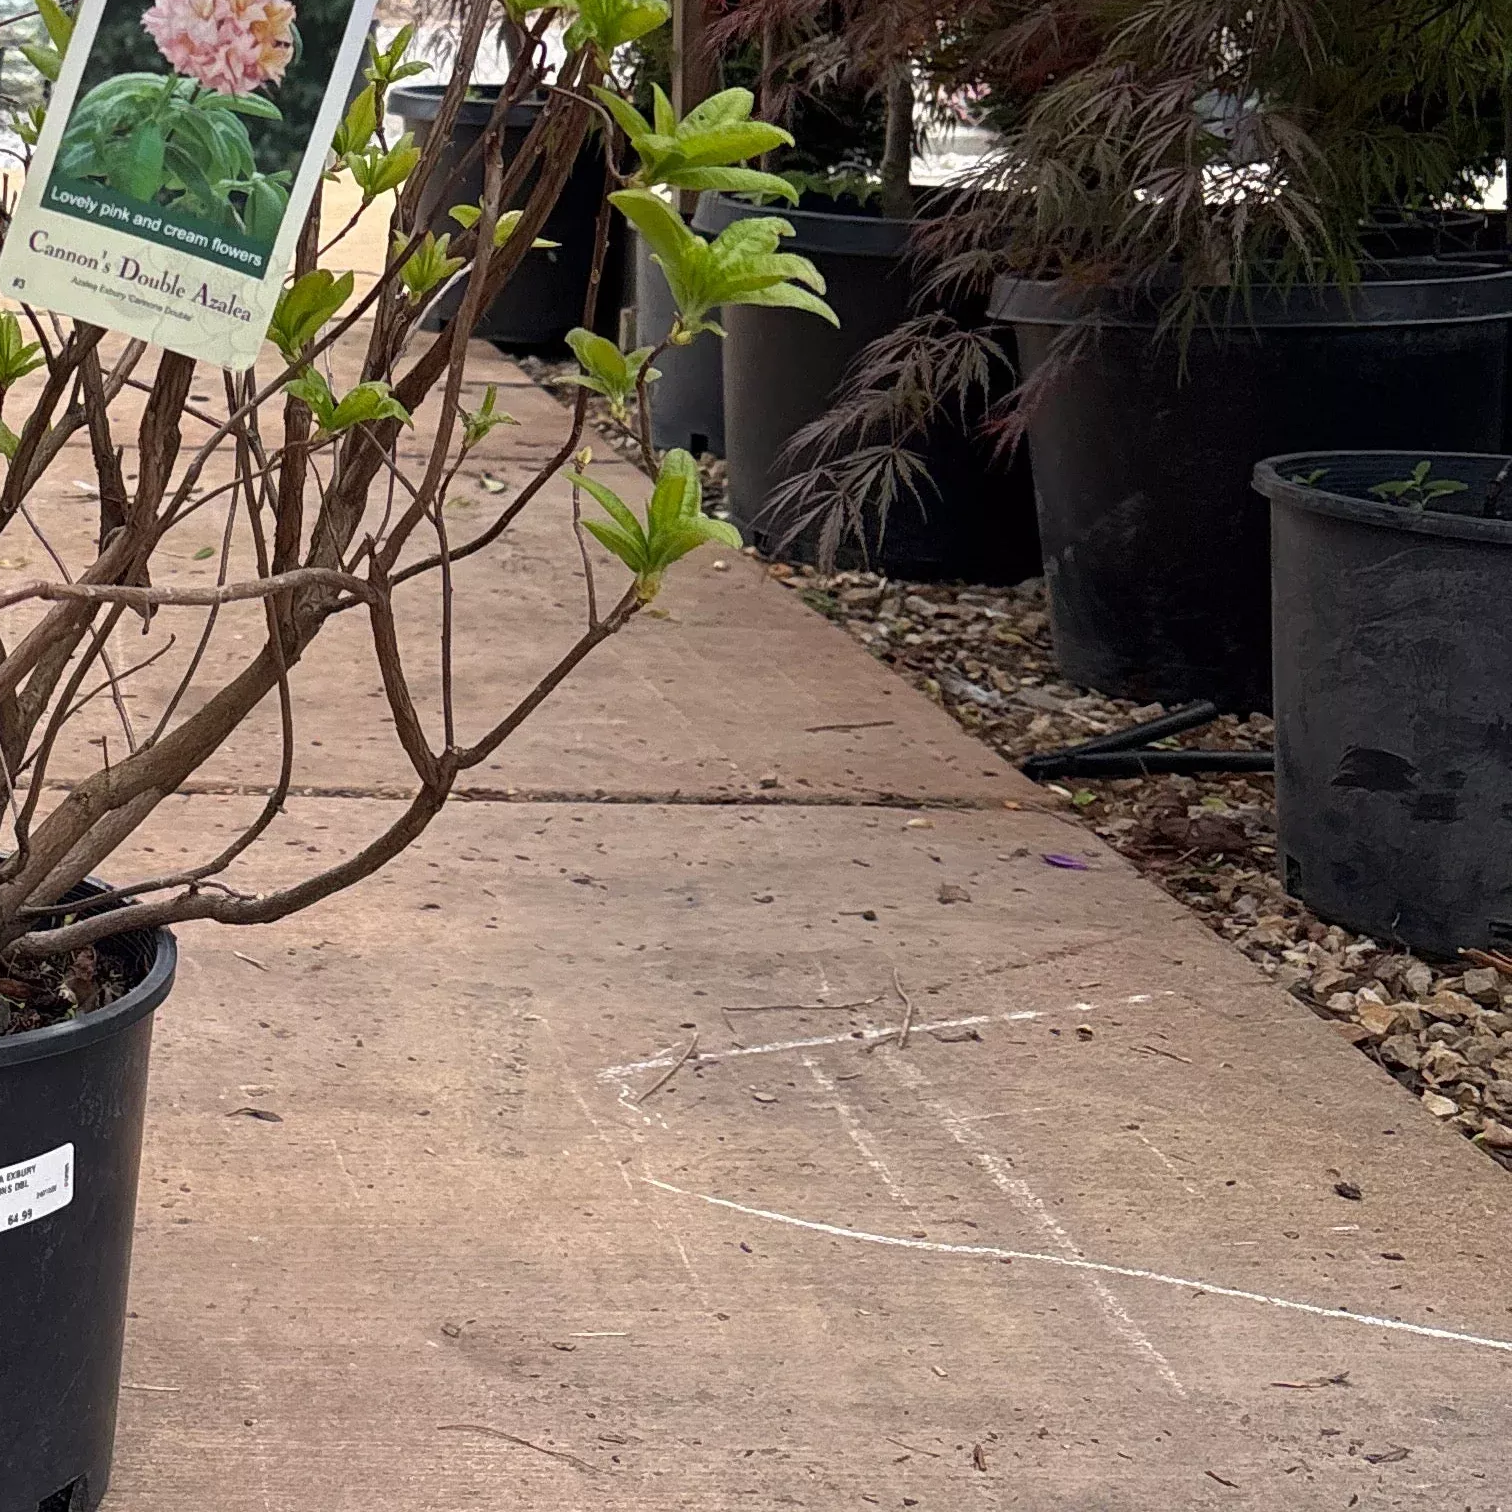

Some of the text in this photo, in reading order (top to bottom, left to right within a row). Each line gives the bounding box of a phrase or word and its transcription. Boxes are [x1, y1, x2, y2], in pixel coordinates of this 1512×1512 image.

[51, 185, 264, 267] Lovely pink and cream flowers
[28, 229, 252, 323] Cannon's Double Azalea
[6, 1165, 36, 1181] EXBURY
[14, 1180, 29, 1192] DBL
